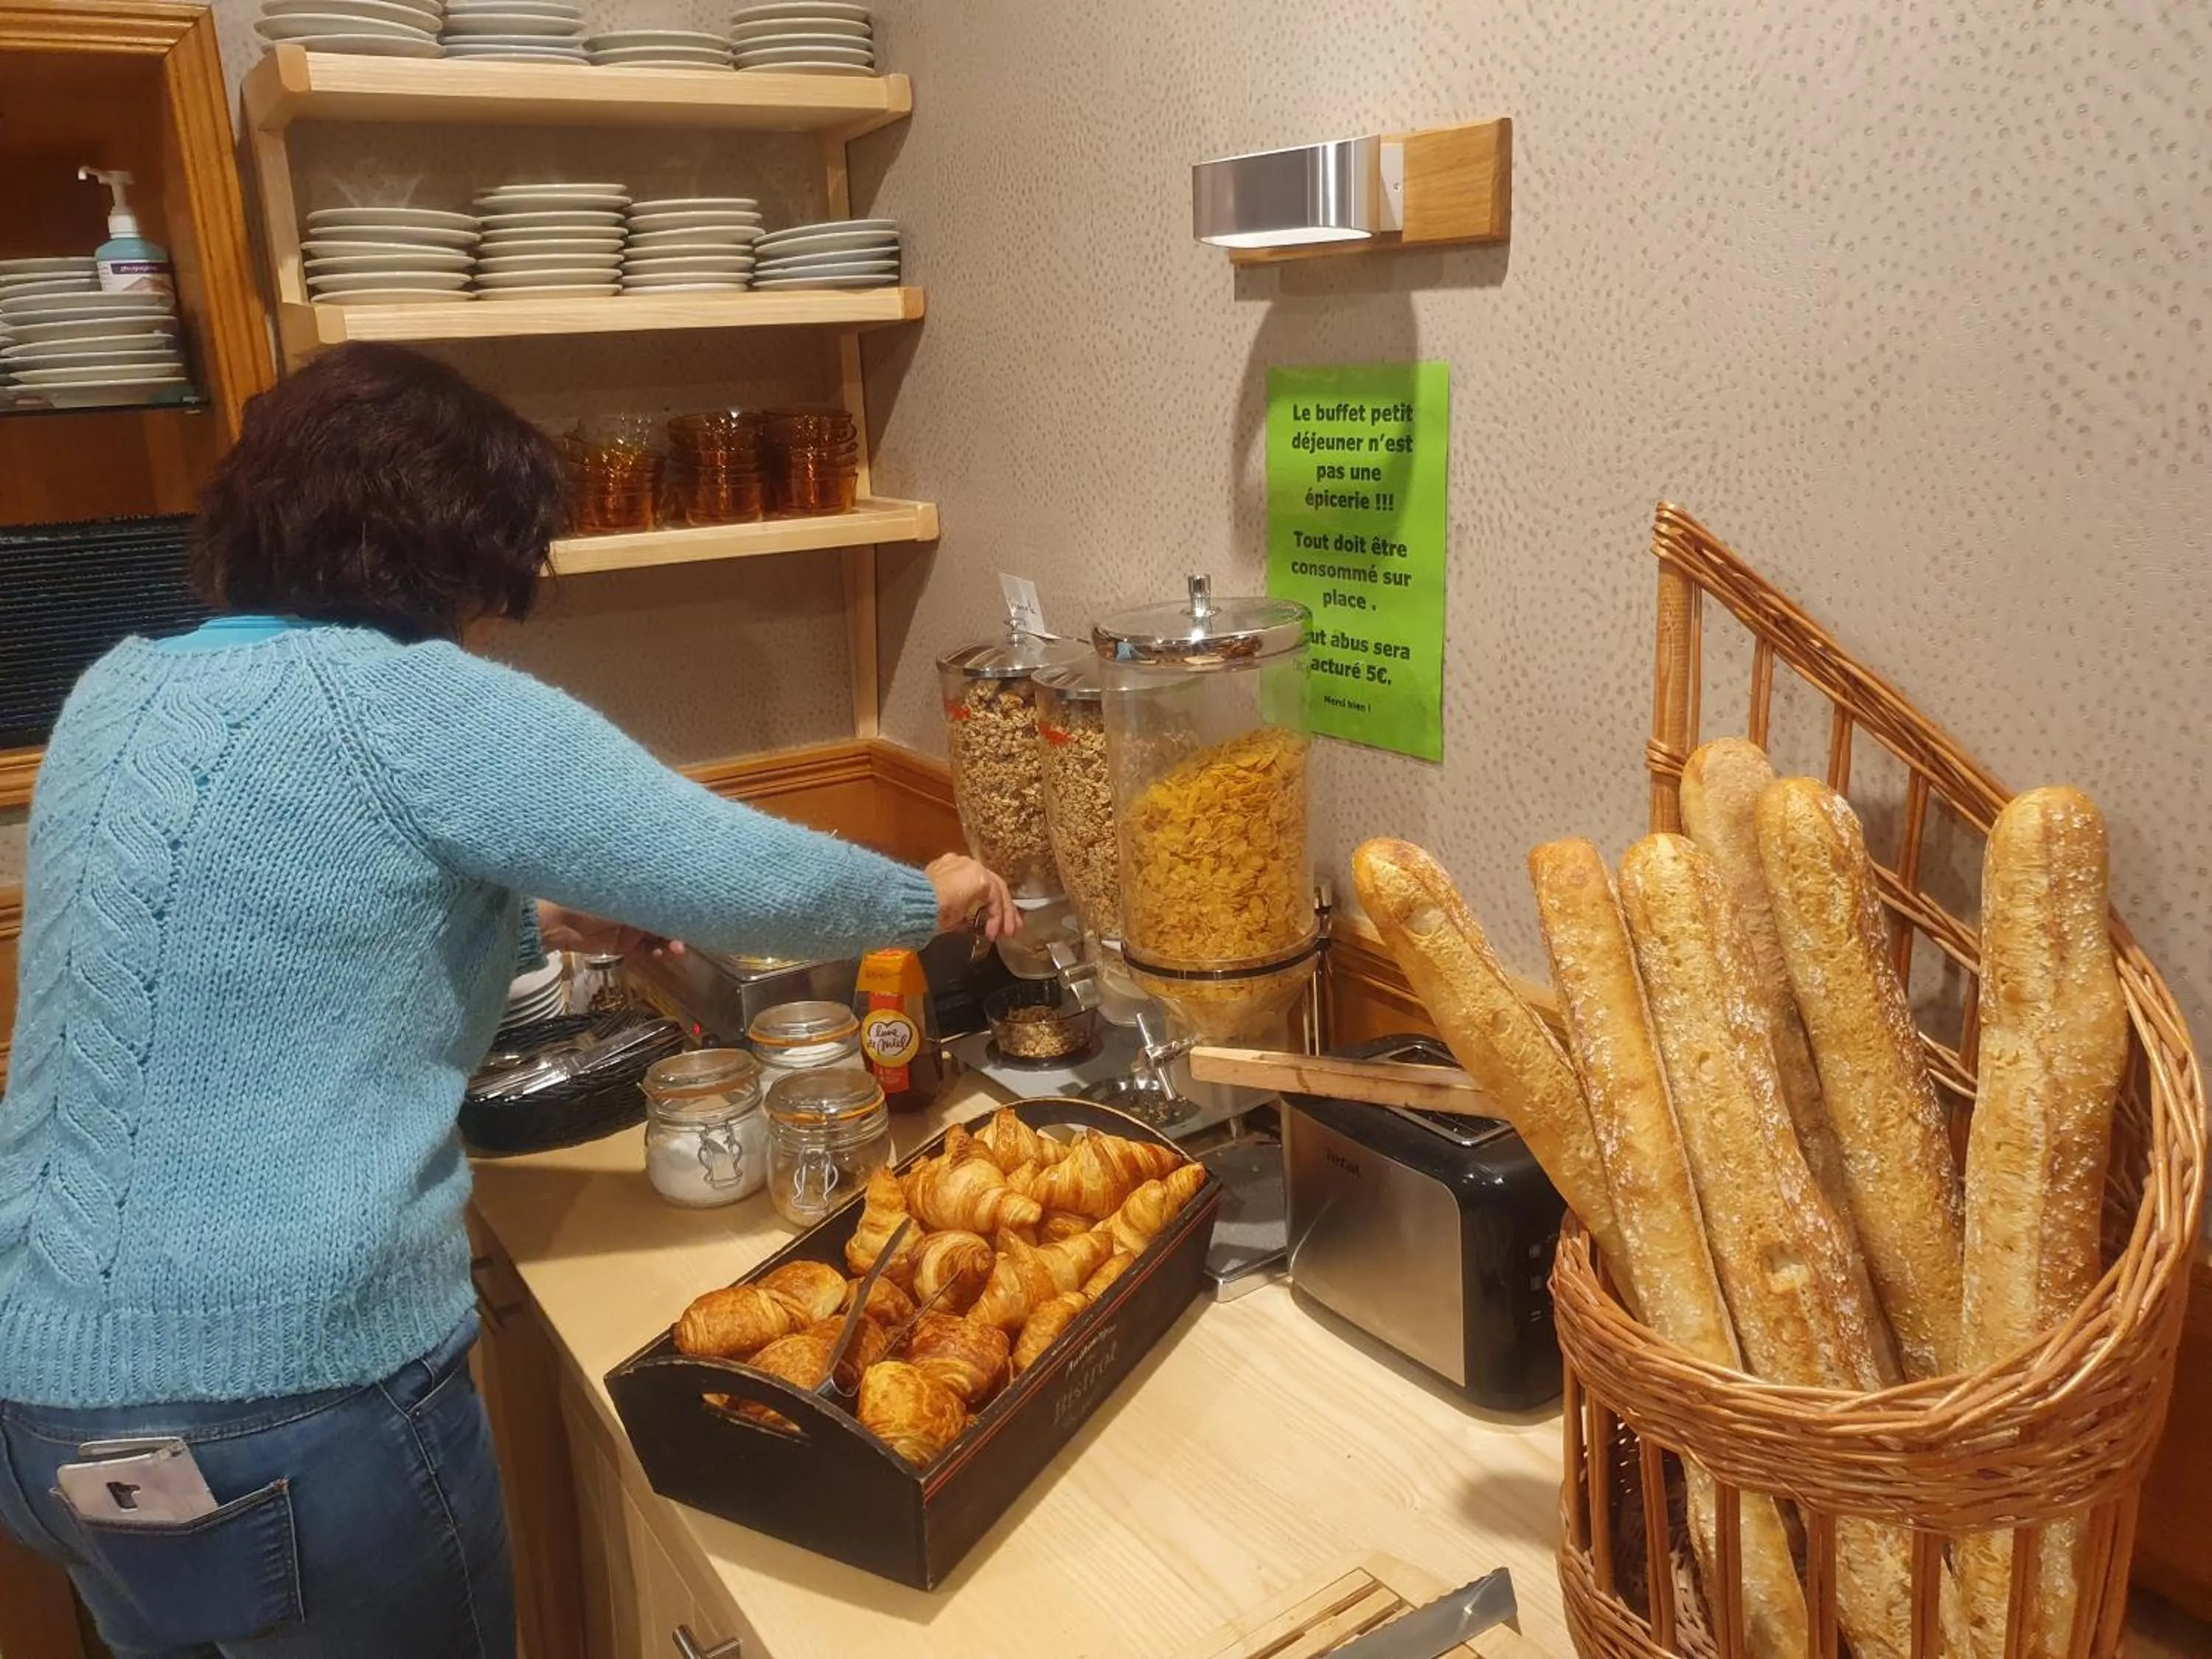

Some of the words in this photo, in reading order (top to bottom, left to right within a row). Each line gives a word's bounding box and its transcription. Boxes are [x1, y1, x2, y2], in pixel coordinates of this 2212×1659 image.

[1293, 404, 1310, 422] Le
[1315, 403, 1366, 422] buffet
[1371, 403, 1413, 426] petit
[1291, 431, 1364, 454] déjeuner
[1317, 465, 1346, 482] pas
[1350, 466, 1381, 481] une
[1305, 487, 1370, 511] épicerie
[1375, 493, 1394, 511] !!!
[1293, 530, 1329, 550] Tout
[1333, 534, 1366, 554] doit
[1371, 536, 1408, 558] être
[1291, 560, 1378, 583] consommé
[1382, 571, 1412, 588] sur
[1322, 589, 1366, 610] place
[1330, 632, 1369, 653] abus
[1373, 641, 1411, 660] sera
[1310, 658, 1361, 679] acturé
[1366, 664, 1392, 685] 5€.
